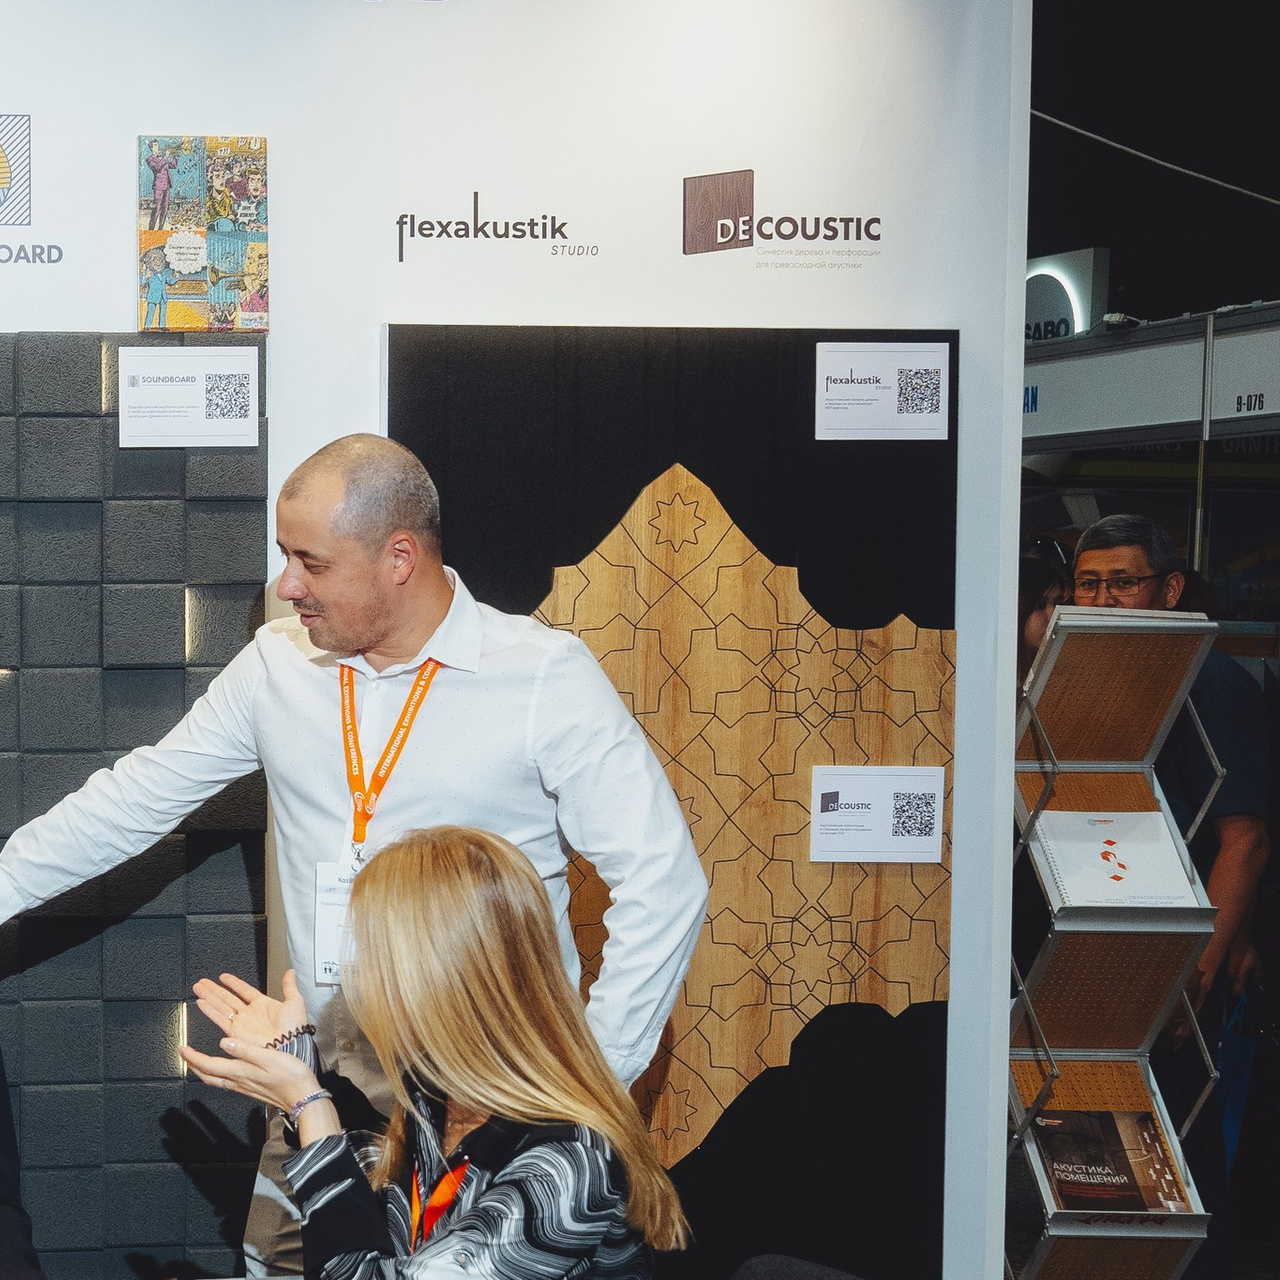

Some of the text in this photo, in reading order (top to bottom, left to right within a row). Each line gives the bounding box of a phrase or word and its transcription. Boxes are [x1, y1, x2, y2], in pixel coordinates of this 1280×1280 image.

[396, 192, 568, 262] flexakustik
[716, 215, 881, 244] DECOUSTIC
[550, 245, 599, 257] STUDIO
[756, 246, 793, 257] Синергия
[794, 248, 824, 257] дерева
[831, 248, 882, 258] перфорации
[755, 261, 770, 269] для
[827, 261, 862, 271] акустики
[141, 375, 197, 384] SOUNDBOARD
[825, 368, 882, 393] flexakustik
[1235, 393, 1265, 413] 9-076
[377, 727, 406, 778] INTERNATIONAL
[403, 683, 424, 727] EXHIBITIONS
[347, 730, 359, 776] CONFERENCES
[1053, 1162, 1113, 1174] АКУСТИКА
[1054, 1170, 1129, 1184] ПОМЕЩЕНИЙ
